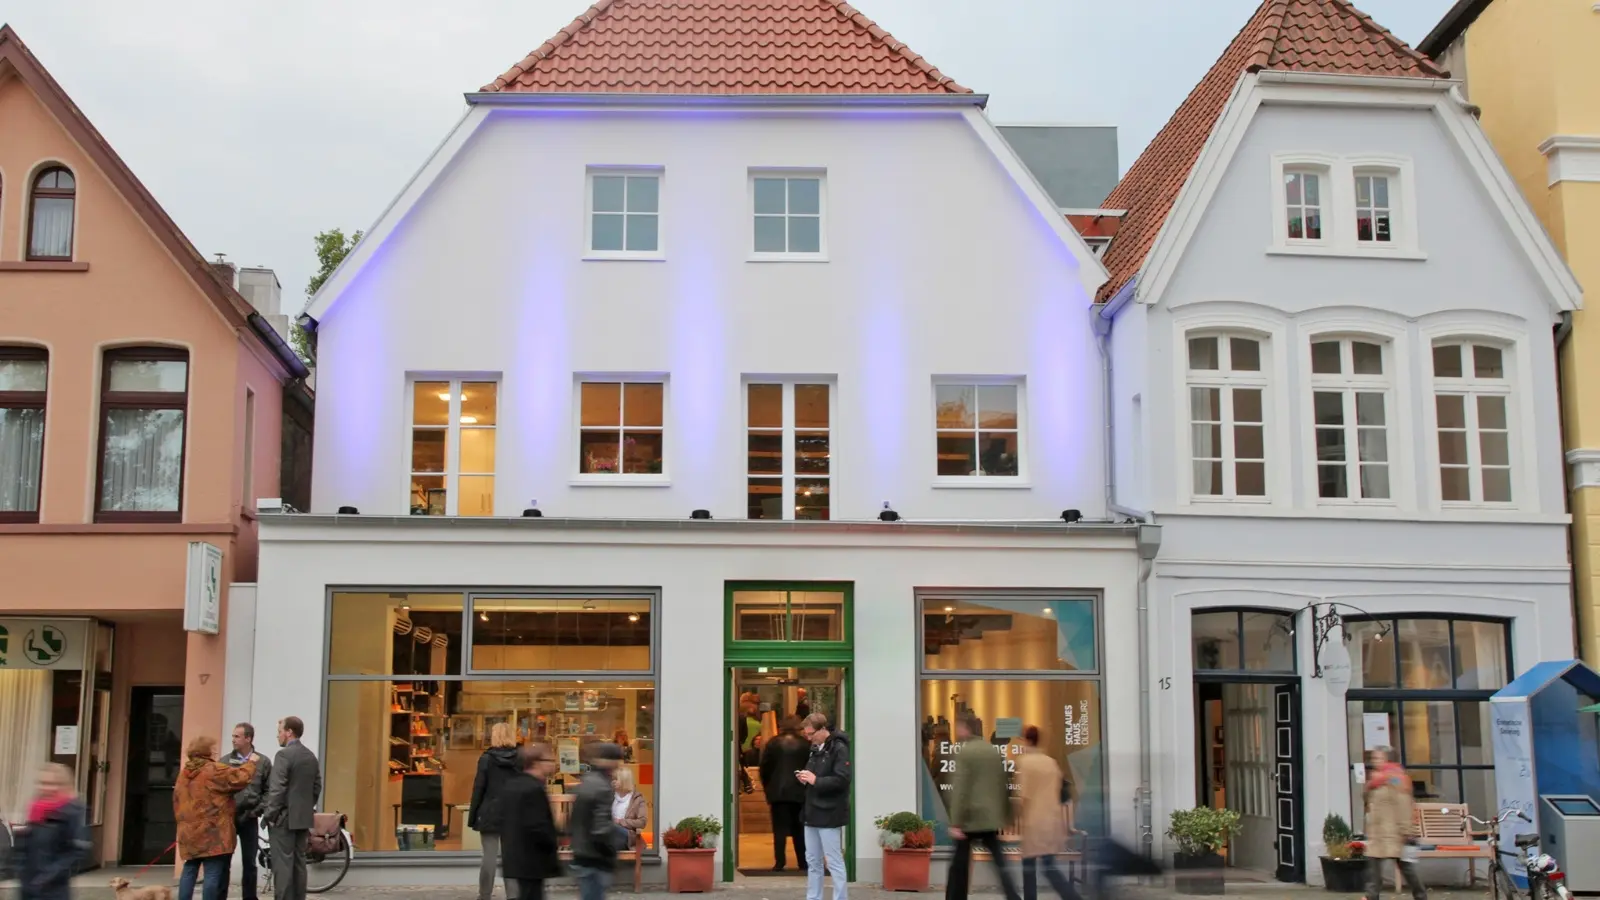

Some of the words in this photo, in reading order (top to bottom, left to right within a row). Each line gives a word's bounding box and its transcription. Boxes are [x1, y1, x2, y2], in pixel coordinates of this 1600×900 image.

[1158, 676, 1171, 690] 15
[1064, 704, 1073, 745] SCHLAUES
[1073, 722, 1081, 745] HAUS
[1080, 699, 1089, 745] OLDENBURG
